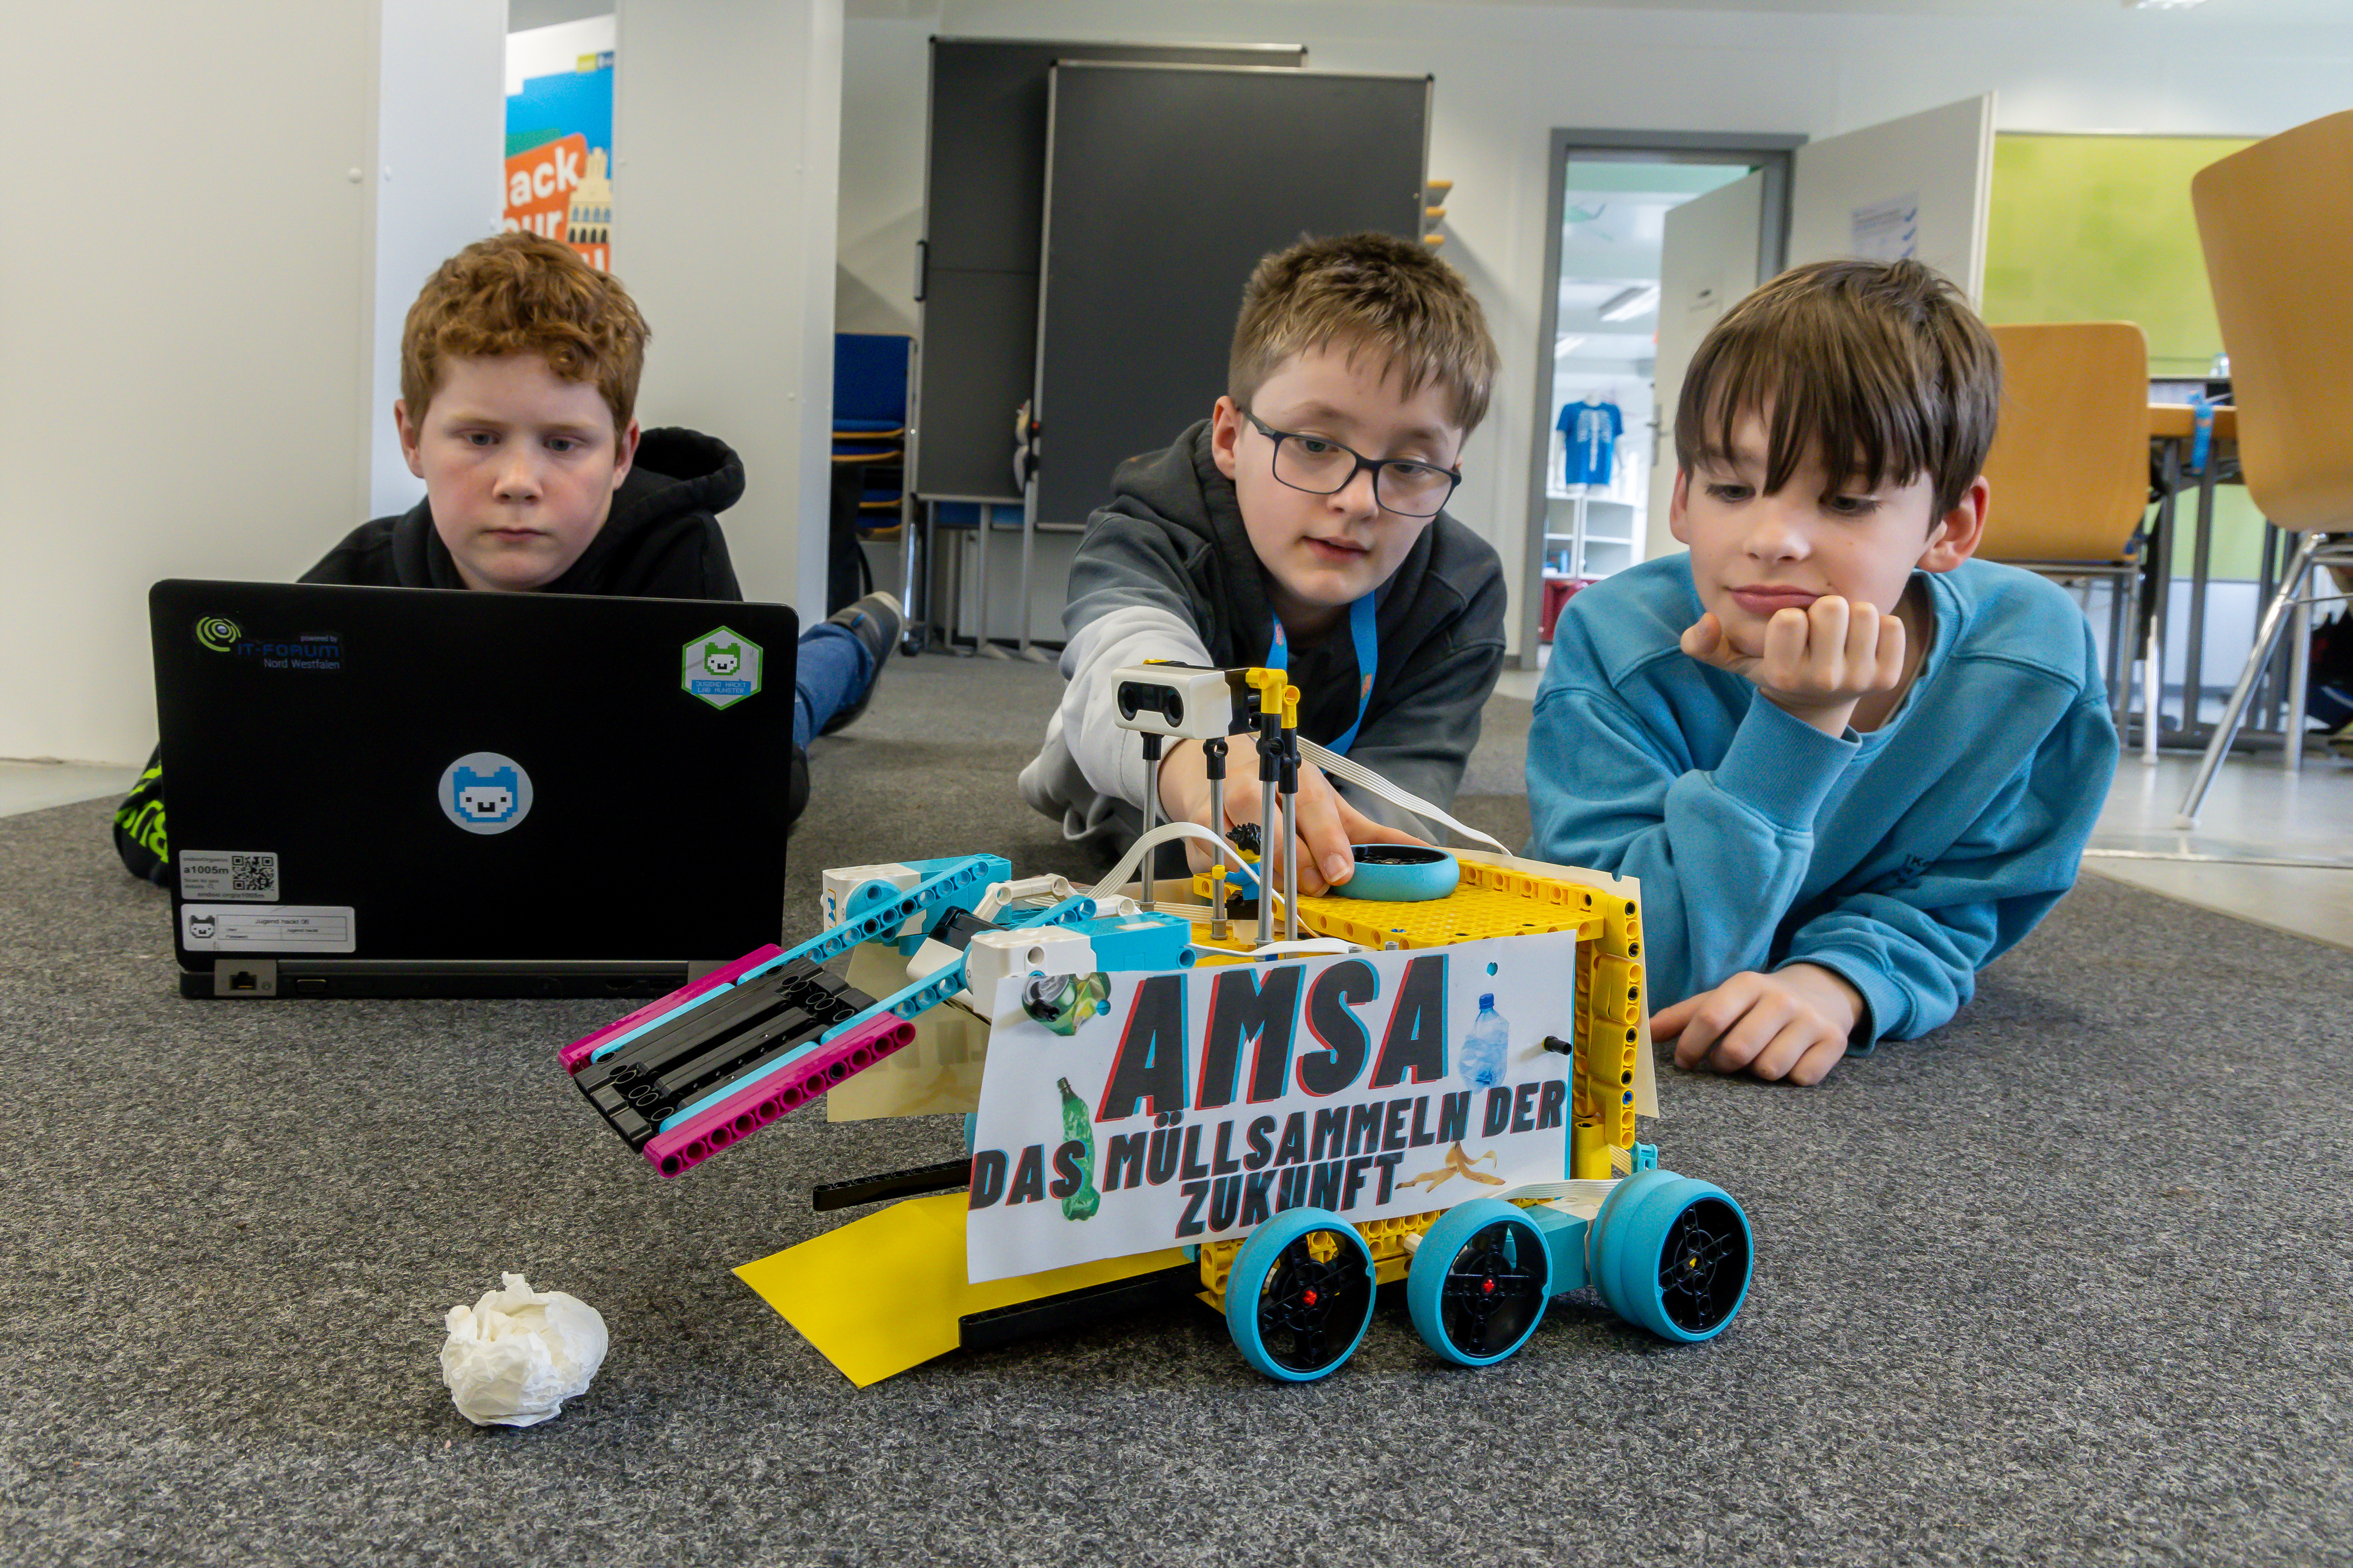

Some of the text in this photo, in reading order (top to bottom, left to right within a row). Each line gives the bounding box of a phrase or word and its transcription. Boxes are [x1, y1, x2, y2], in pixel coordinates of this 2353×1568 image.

[508, 146, 579, 207] ack
[264, 658, 341, 669] Nord Westfalen
[183, 866, 229, 875] a1005m
[1095, 953, 1449, 1123] AMSA
[968, 1080, 1568, 1210] DAS MÜLLSAMMELN DER
[1175, 1151, 1405, 1239] ZUKUNFT
